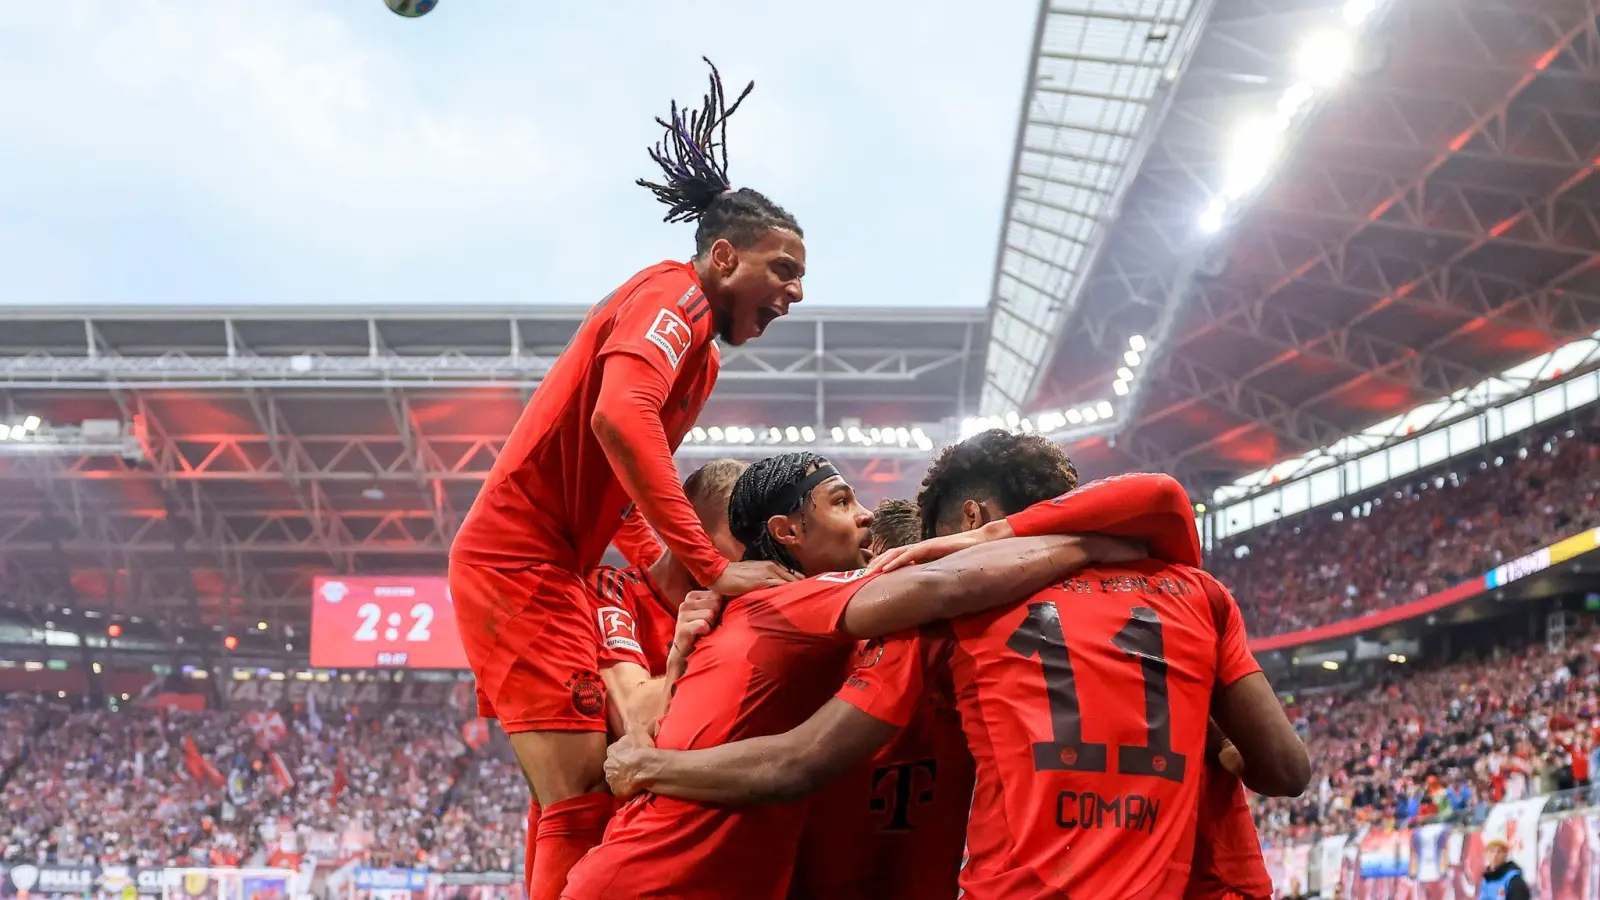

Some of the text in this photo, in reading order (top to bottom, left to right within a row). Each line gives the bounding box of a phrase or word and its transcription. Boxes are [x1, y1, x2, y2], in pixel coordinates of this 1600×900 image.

[1100, 574, 1193, 597] MÜNCHEN
[353, 602, 434, 641] 2:2
[606, 638, 640, 649] BUNDESLIGA
[1005, 601, 1186, 783] 11
[869, 758, 937, 831] T
[1055, 790, 1160, 834] COMAN
[39, 869, 91, 886] BULLS
